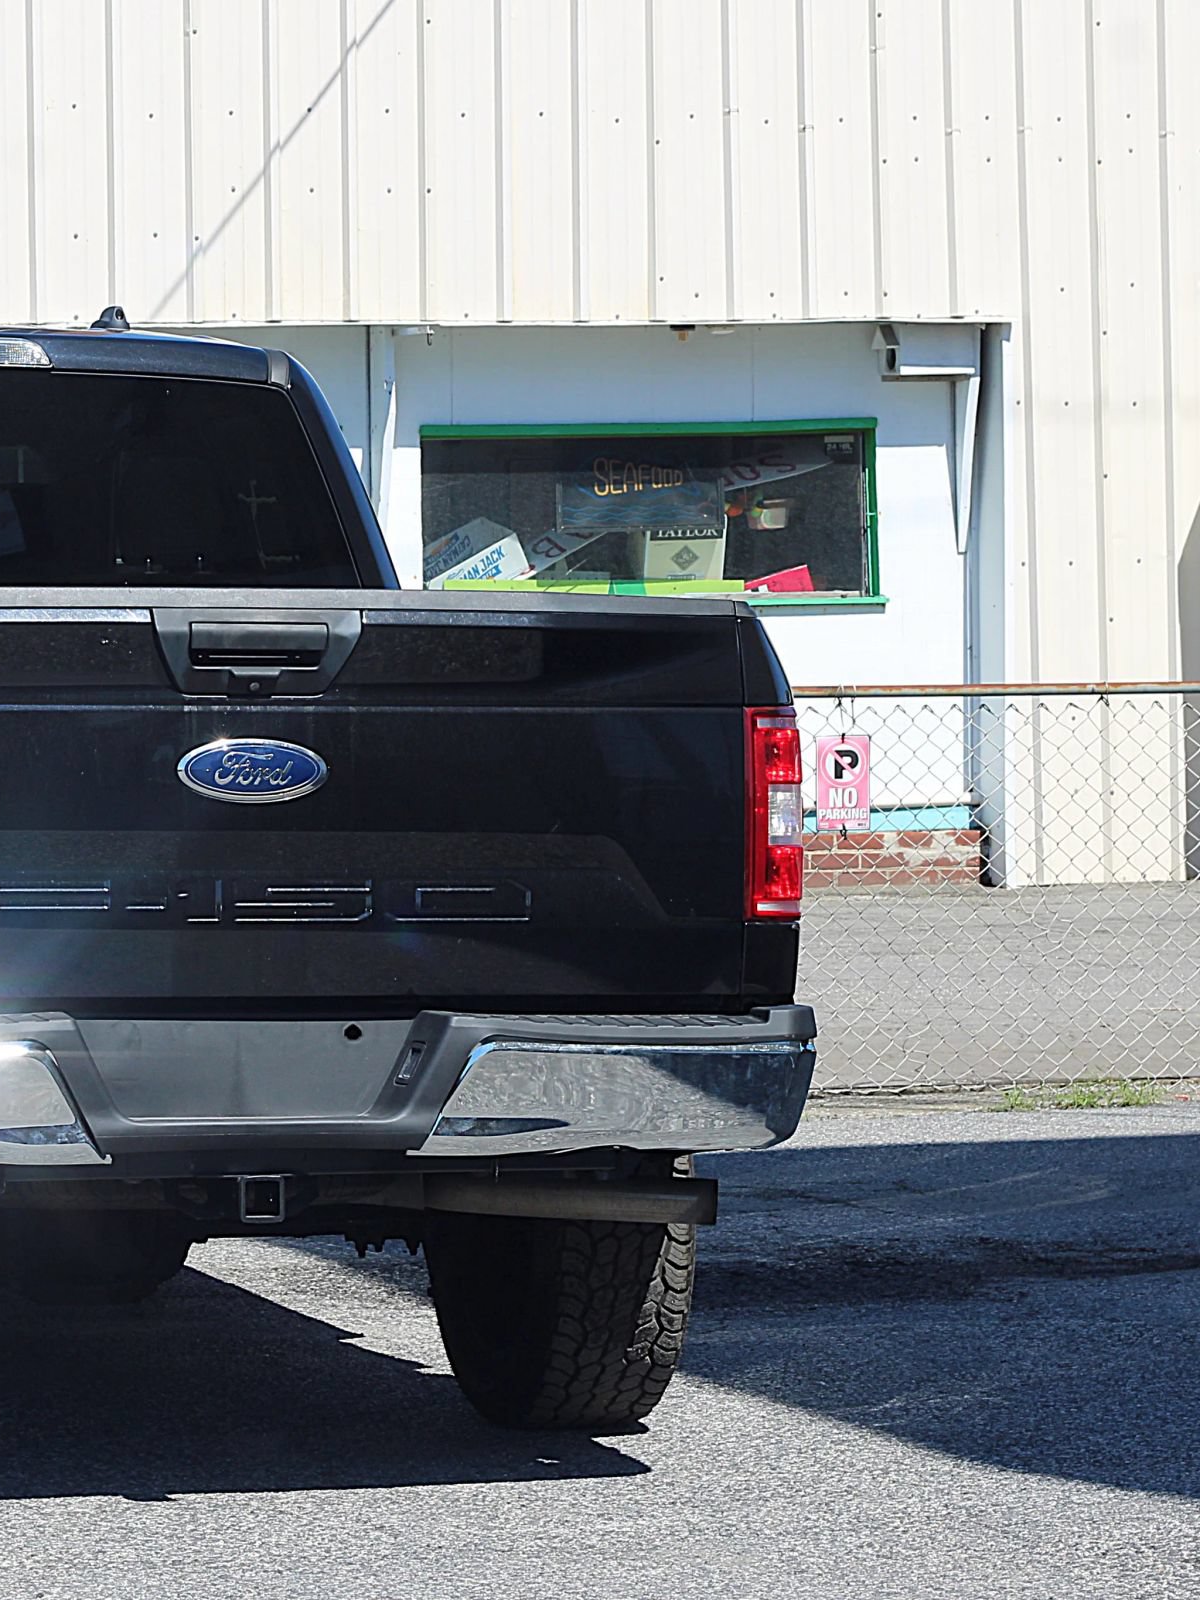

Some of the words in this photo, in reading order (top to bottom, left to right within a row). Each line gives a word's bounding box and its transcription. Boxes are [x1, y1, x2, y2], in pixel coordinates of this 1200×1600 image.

[593, 457, 684, 496] SEAFOOD
[657, 529, 718, 538] TAYLOR
[479, 545, 505, 572] JACK
[215, 751, 293, 786] Ford
[828, 787, 858, 808] NO
[819, 808, 867, 820] PARKING
